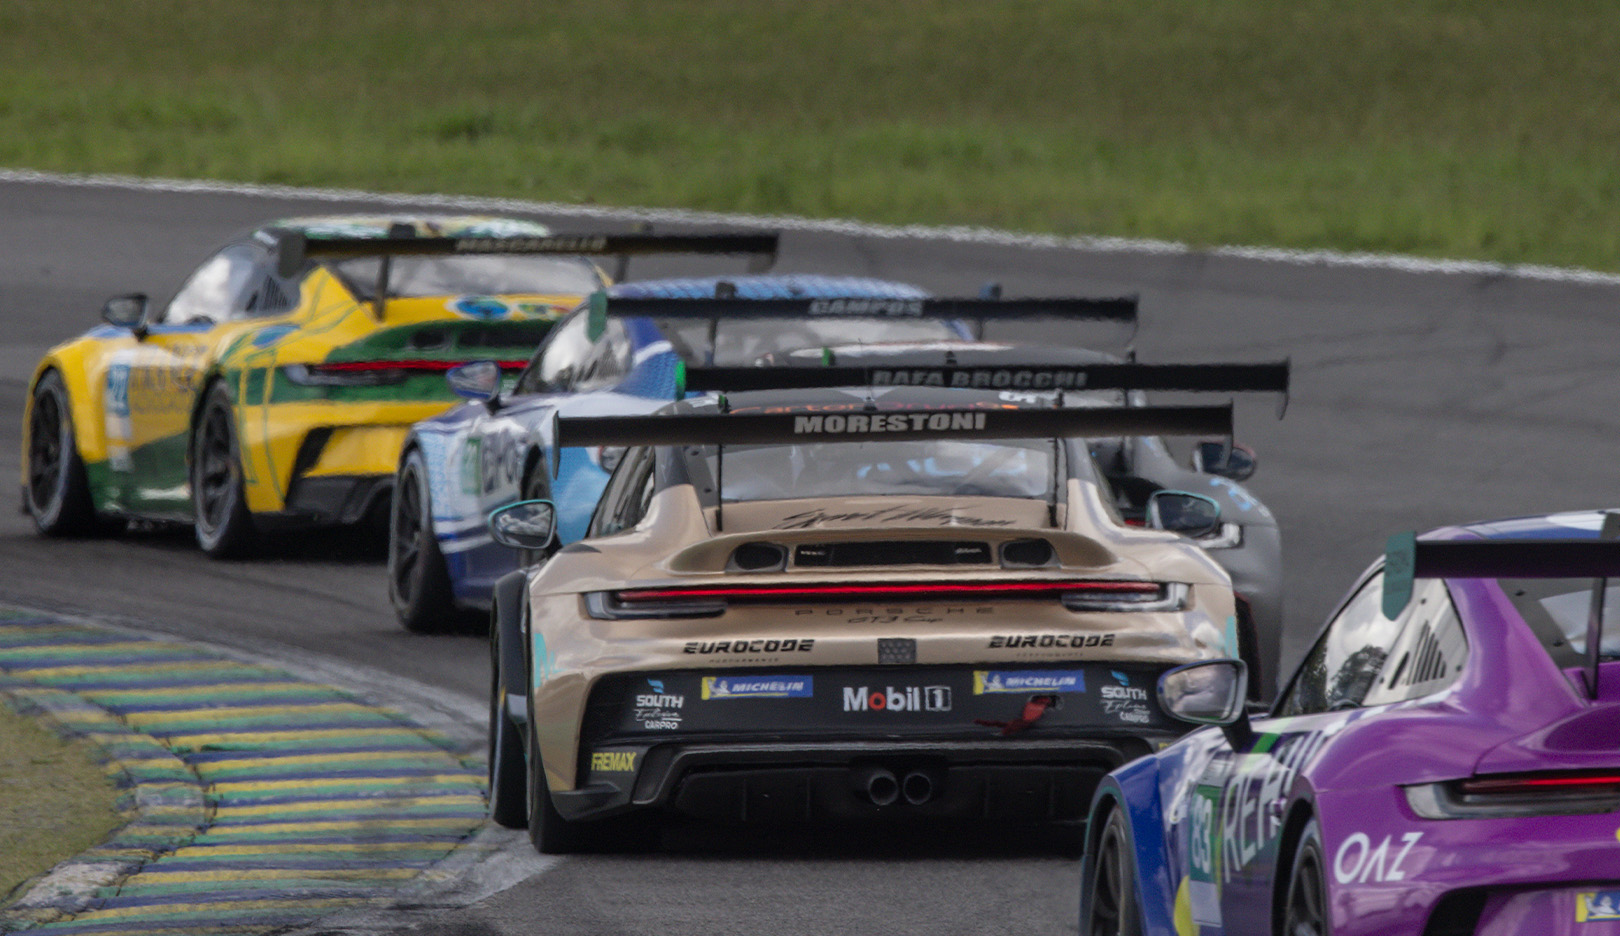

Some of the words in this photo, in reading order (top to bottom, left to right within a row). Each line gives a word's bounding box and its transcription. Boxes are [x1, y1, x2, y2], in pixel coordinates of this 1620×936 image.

[809, 299, 923, 316] CAMPOS
[873, 370, 944, 387] RAFA
[951, 370, 1088, 387] BROCCHI
[794, 412, 986, 434] MORESTONI
[795, 607, 993, 616] PORSCHE
[847, 616, 899, 625] GT3
[903, 616, 944, 625] Cup
[684, 639, 815, 655] EUROCODE
[732, 681, 804, 693] MICHELIN
[1005, 676, 1077, 688] MICHELIN
[843, 686, 921, 711] Mobil
[1101, 686, 1148, 700] SOUTH
[636, 694, 685, 709] SOUTH
[644, 720, 679, 730] CARPRO
[591, 752, 637, 772] FREMAX
[1191, 793, 1213, 875] 83
